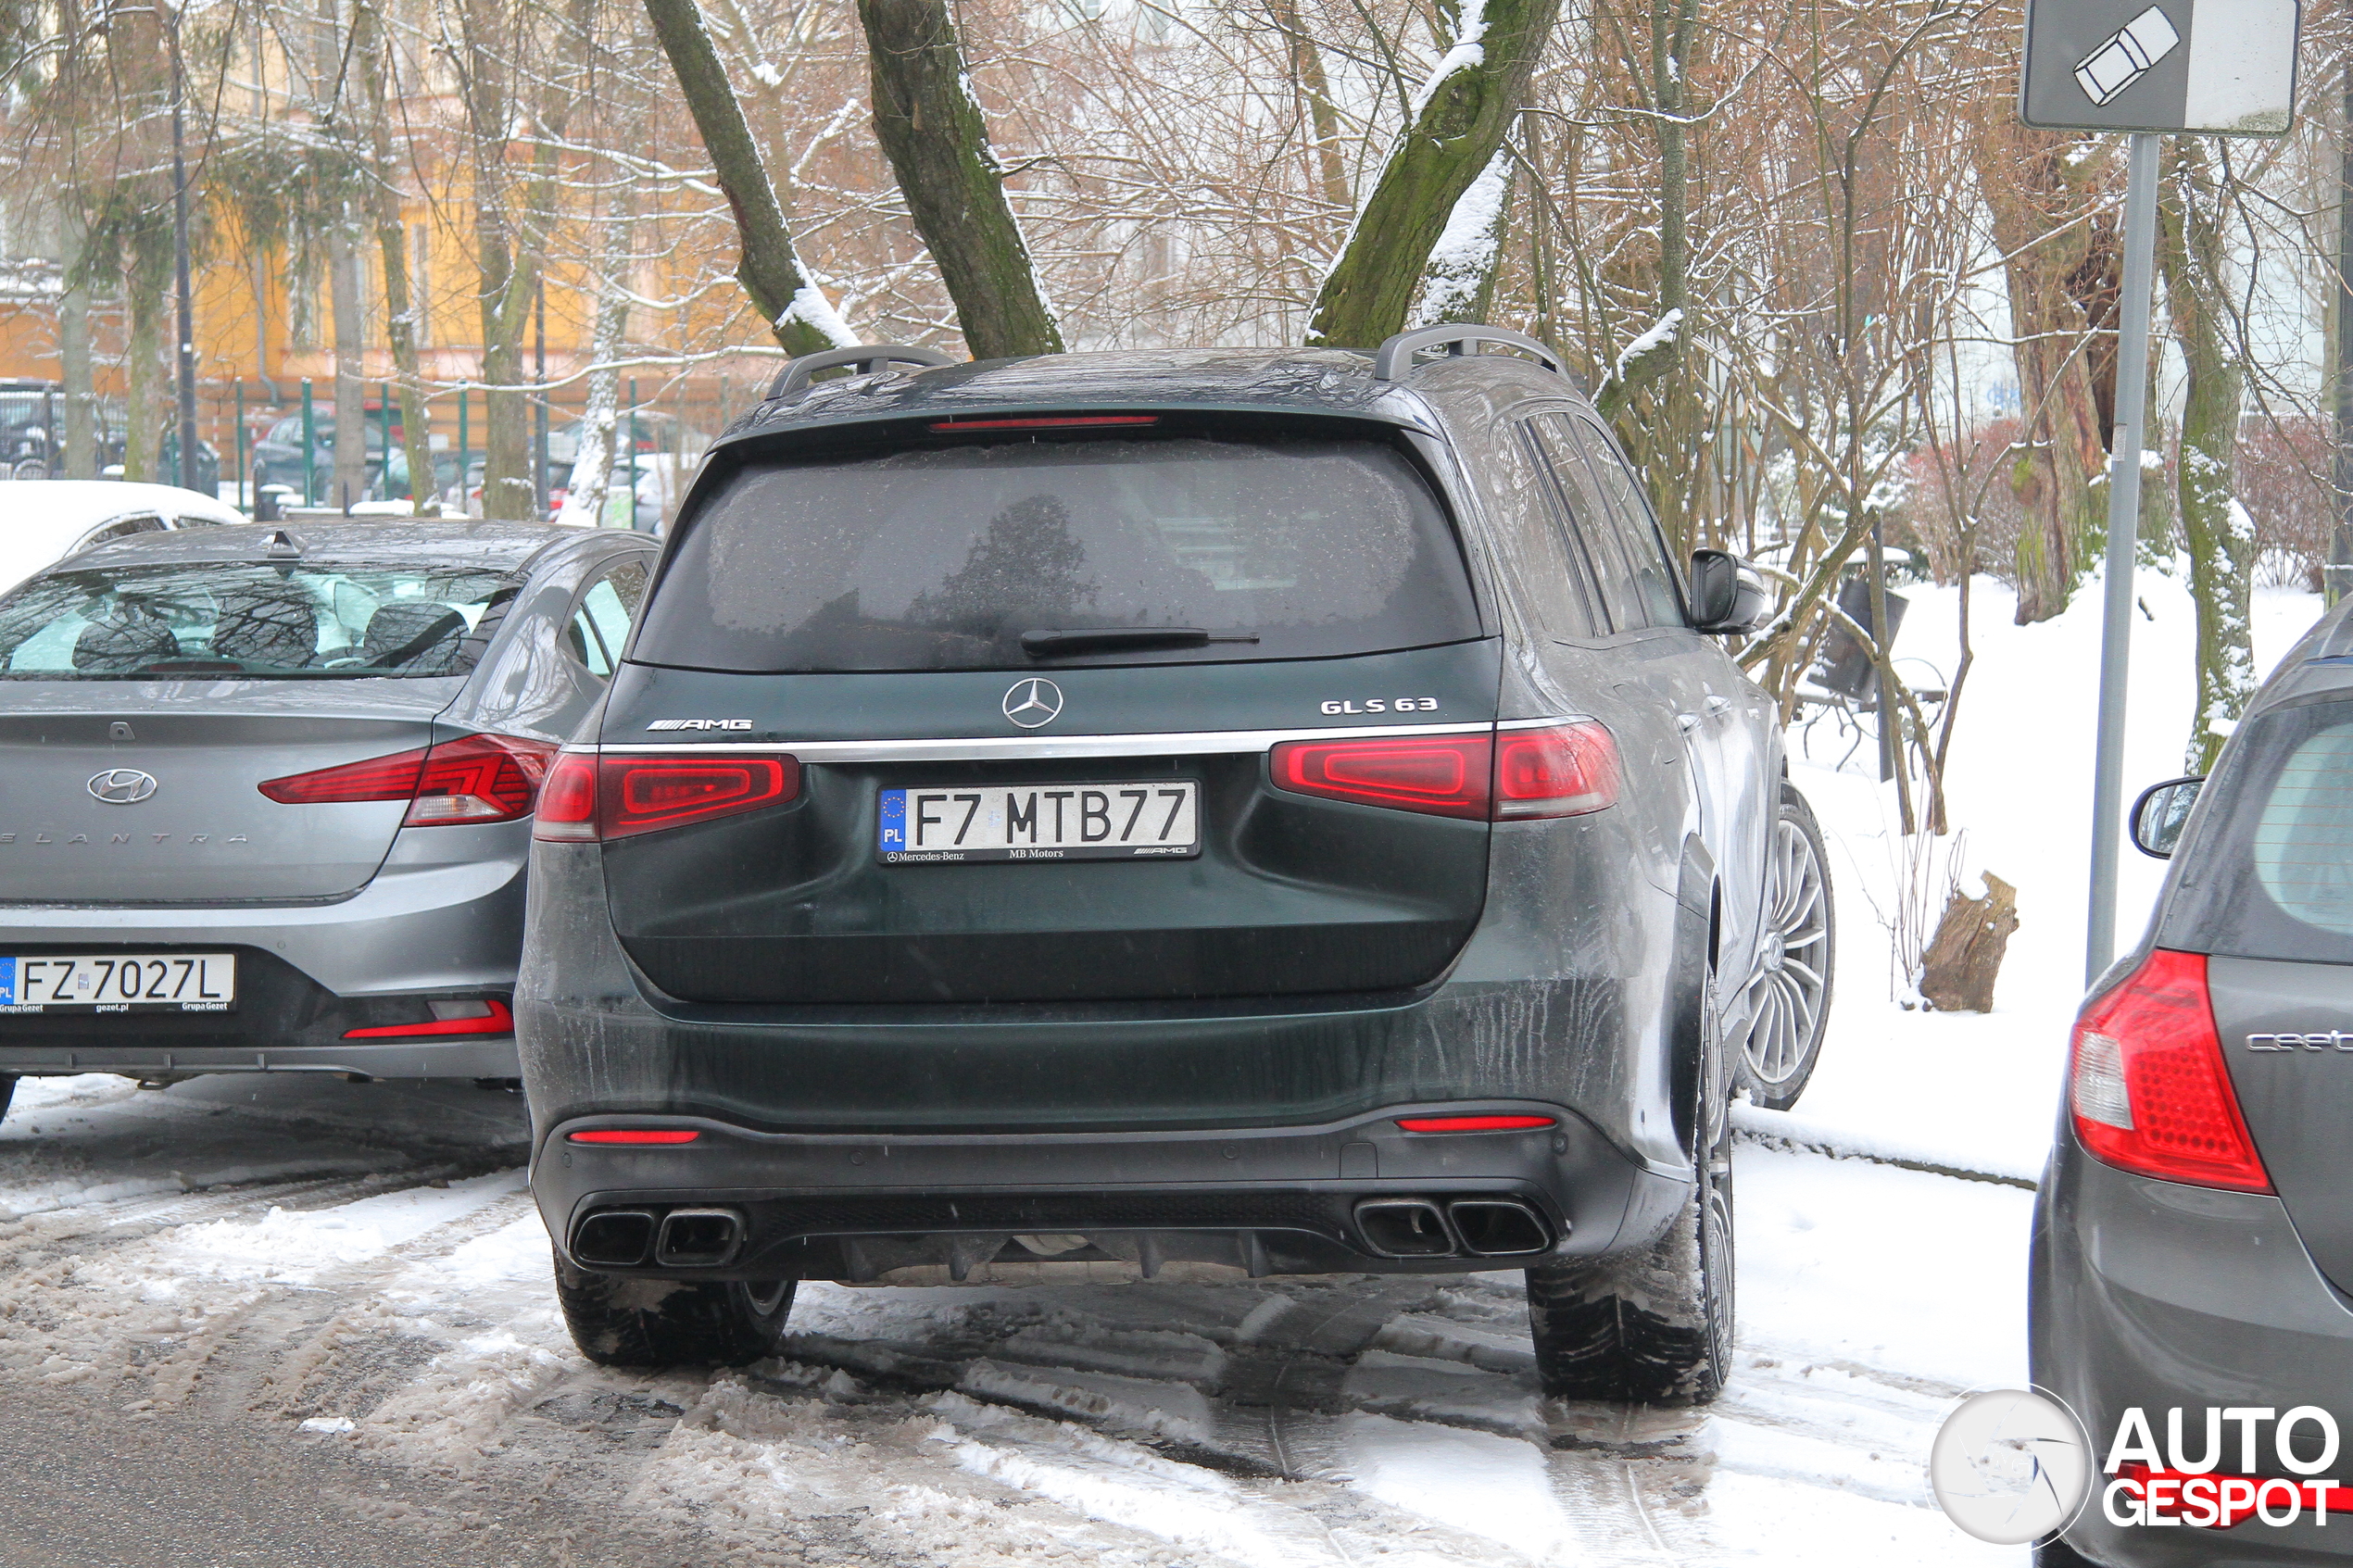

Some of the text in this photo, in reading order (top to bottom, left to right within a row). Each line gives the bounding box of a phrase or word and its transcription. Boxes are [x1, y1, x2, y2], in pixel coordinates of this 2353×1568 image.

[1321, 697, 1439, 715] GLS 63
[916, 789, 1187, 847] F7 MTB77
[0, 833, 248, 844] ELANTRA
[884, 829, 902, 843] PL
[899, 851, 964, 861] Mercedes-Benz
[1010, 849, 1063, 859] MB Motors
[24, 960, 220, 1000] FZ 7027L
[0, 1004, 44, 1013] Grupa Gezet
[95, 1003, 129, 1012] gezet.pl
[182, 1002, 228, 1010] Grupa Gezet
